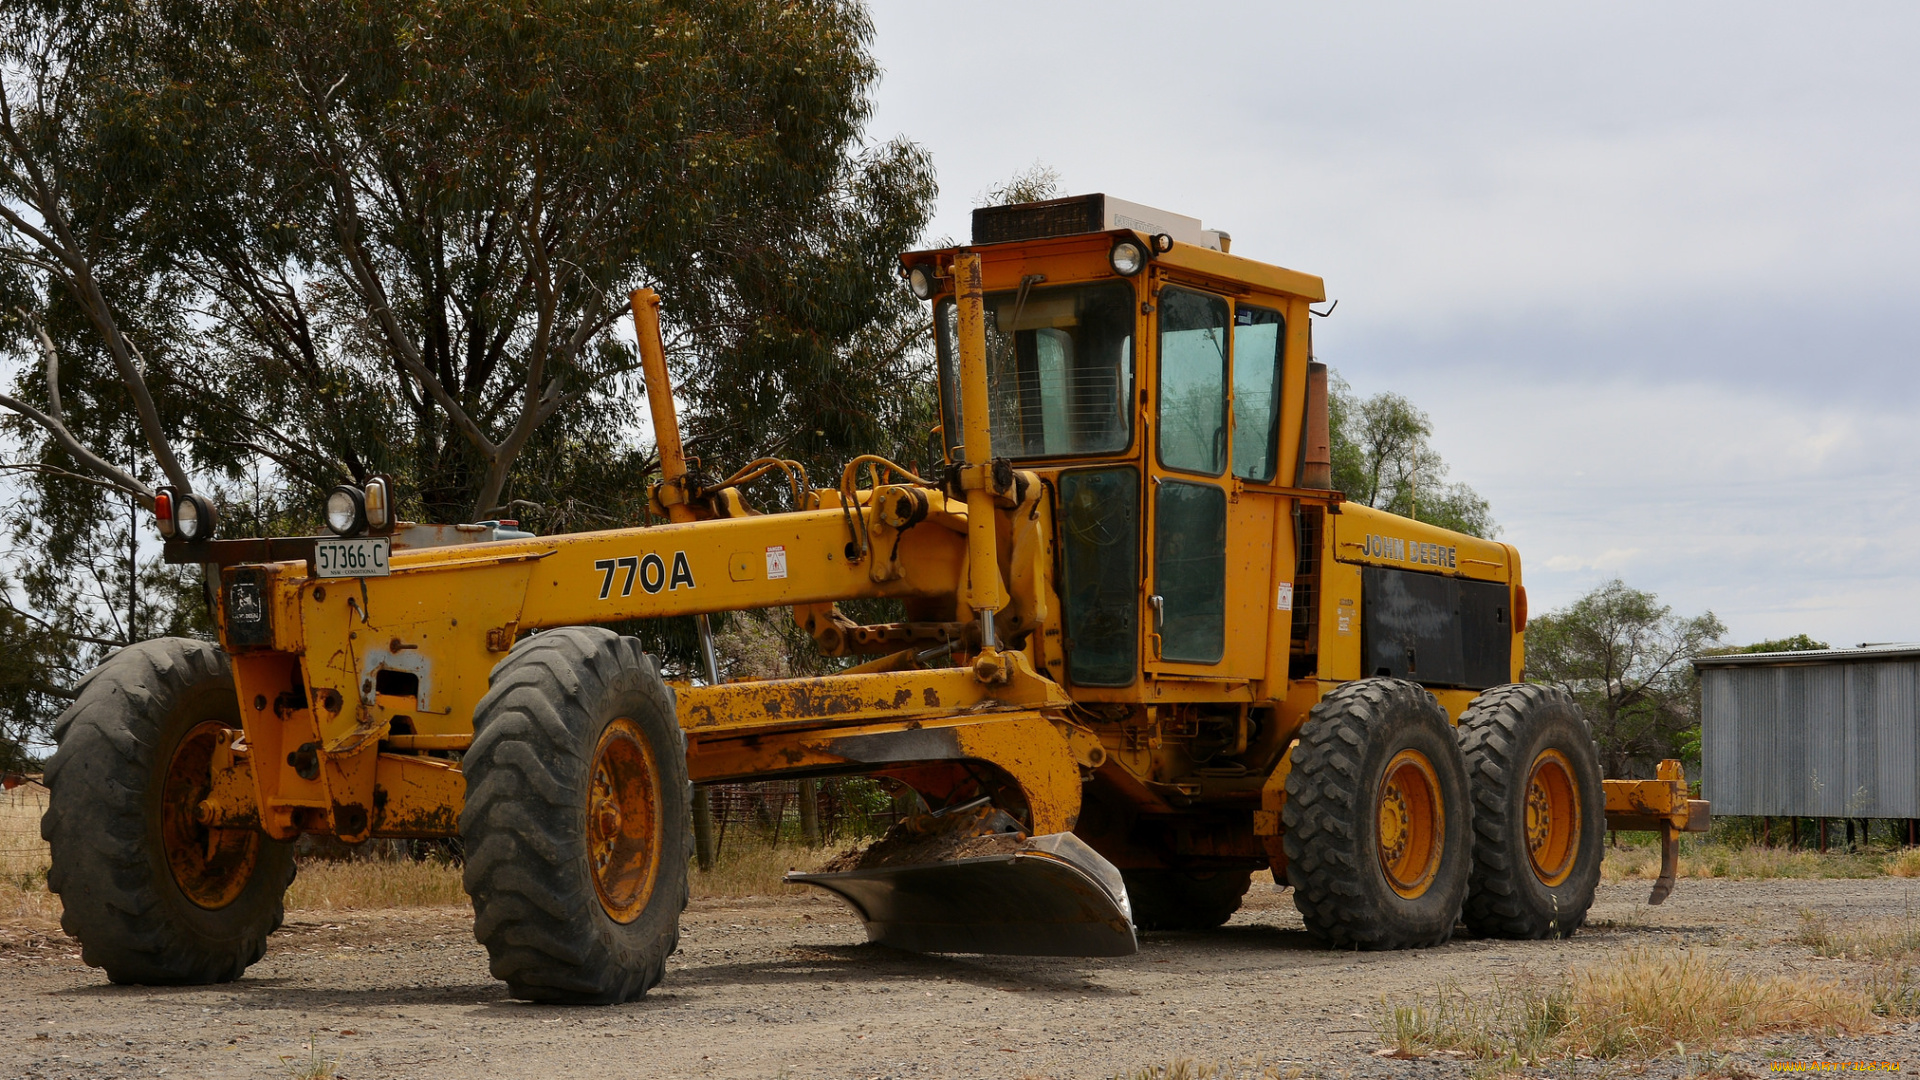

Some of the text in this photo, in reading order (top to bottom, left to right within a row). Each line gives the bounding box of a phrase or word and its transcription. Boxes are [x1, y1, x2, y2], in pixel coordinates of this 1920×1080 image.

[1362, 534, 1456, 569] JOHN DEERE
[594, 550, 696, 600] 770A
